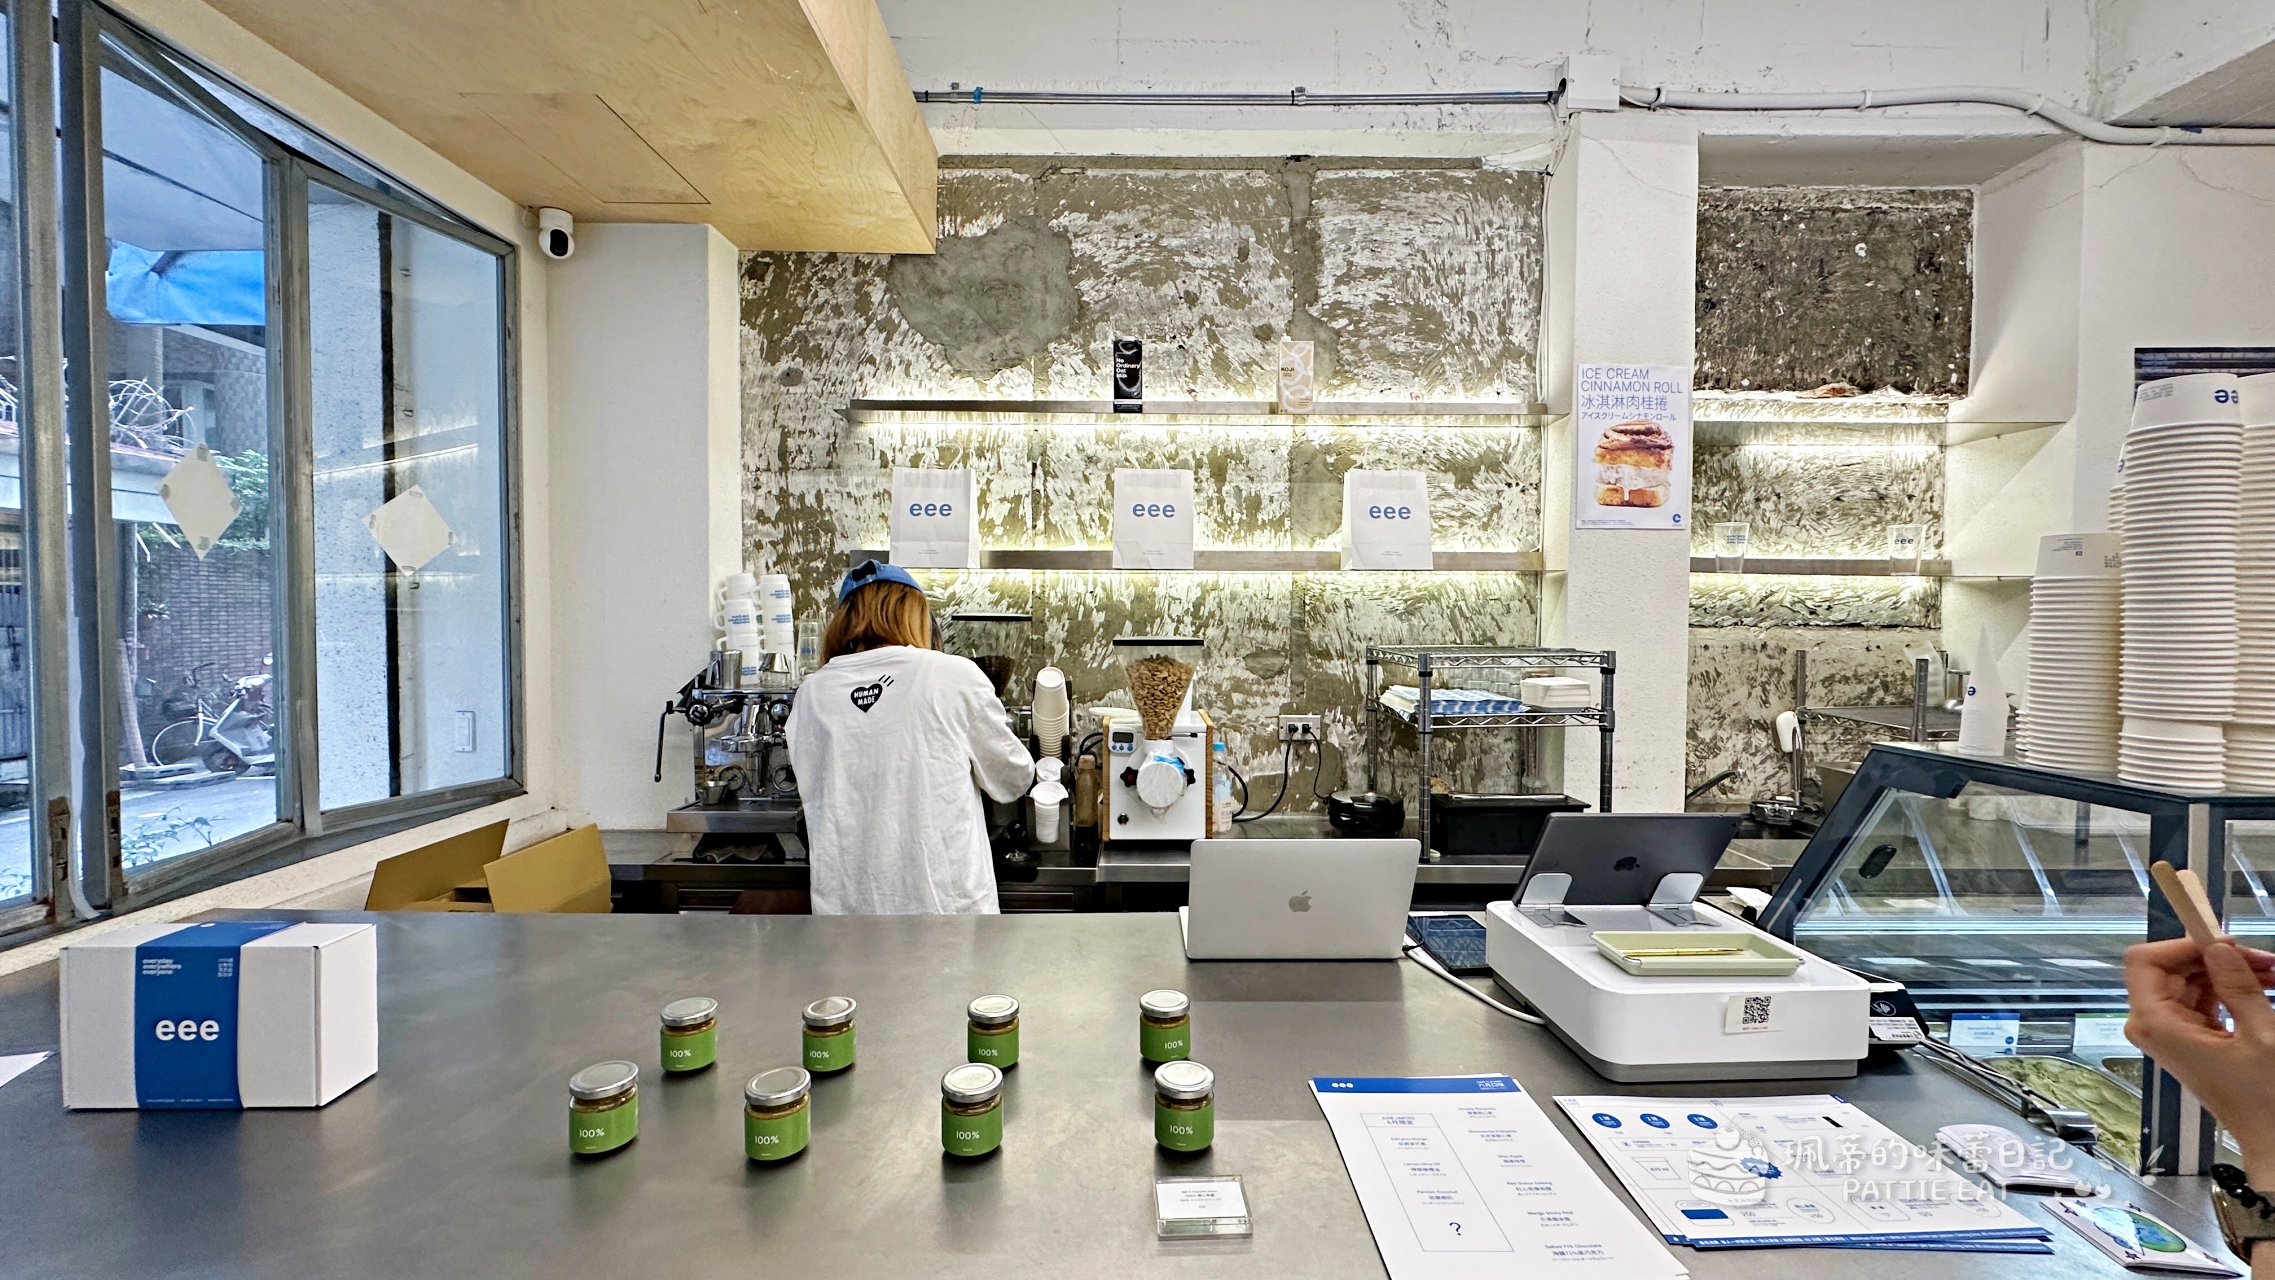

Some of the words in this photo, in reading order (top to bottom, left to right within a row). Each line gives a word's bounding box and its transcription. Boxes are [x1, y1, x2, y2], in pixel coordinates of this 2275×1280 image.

[1582, 368, 1601, 380] ICE
[1606, 368, 1649, 380] CREAM
[1581, 380, 1651, 392] CINNAMON
[1654, 381, 1684, 394] ROLL
[1581, 394, 1668, 411] 冰淇淋肉桂捲
[1581, 411, 1677, 421] アイスクリームシナモンロール
[909, 503, 952, 517] eee
[1132, 504, 1175, 518] eee
[1369, 505, 1411, 520] eee
[854, 688, 879, 698] HUMAN
[857, 696, 875, 706] MADE
[155, 1019, 220, 1041] eee
[1164, 1039, 1183, 1049] 100%
[670, 1049, 692, 1058] 100%
[810, 1050, 830, 1059] 100%
[978, 1048, 999, 1057] 100%
[579, 1128, 605, 1138] 100%
[956, 1130, 980, 1140] 100%
[1170, 1125, 1194, 1135] 100%
[754, 1135, 779, 1145] 100%
